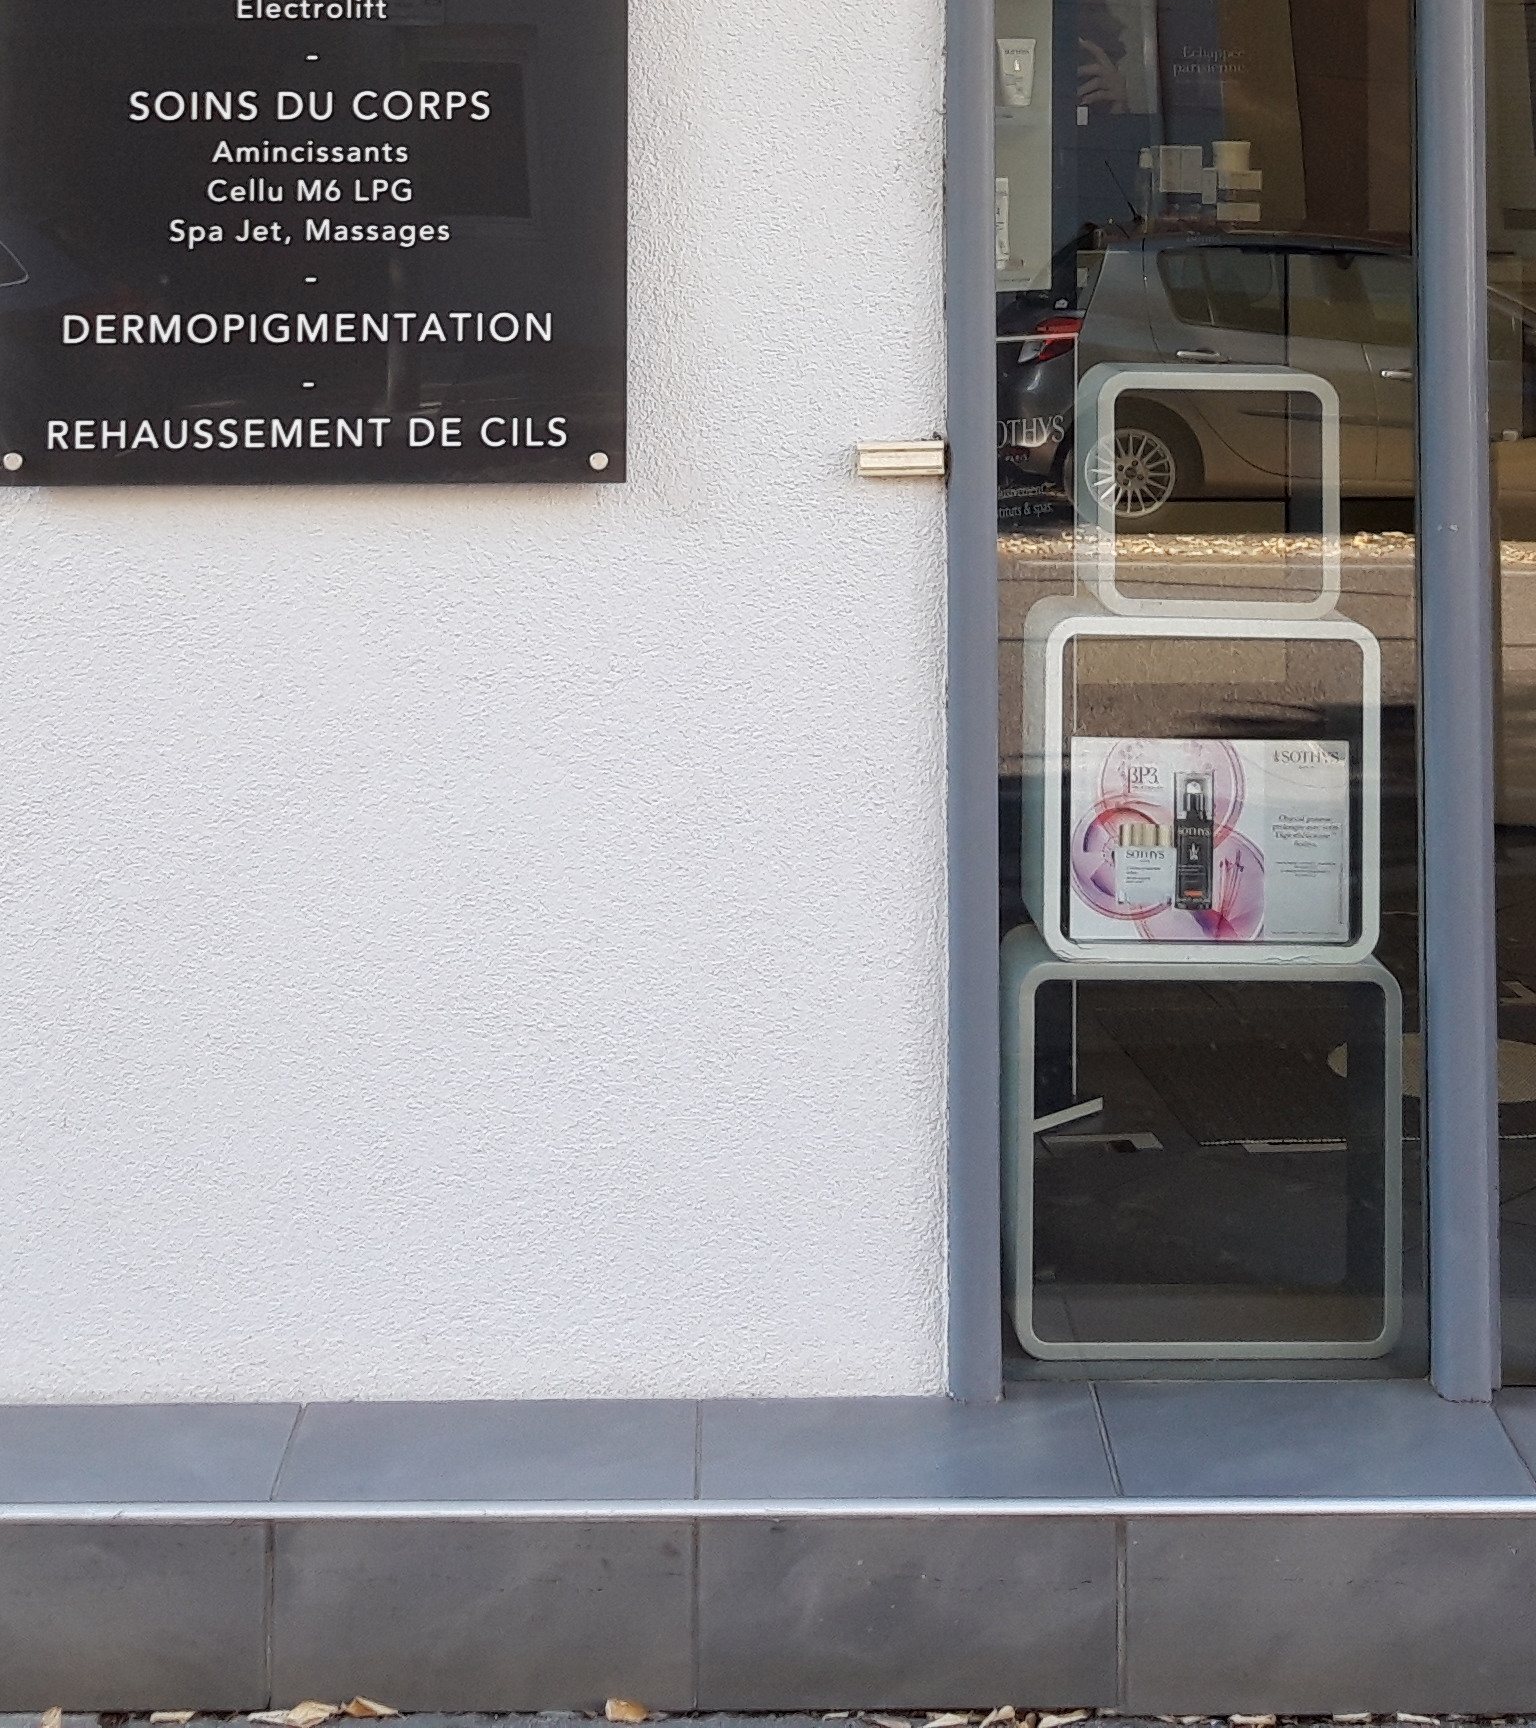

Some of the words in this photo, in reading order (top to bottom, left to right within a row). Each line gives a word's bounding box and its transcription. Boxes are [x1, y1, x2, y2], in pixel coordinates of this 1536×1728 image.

[130, 91, 257, 120] SOINS
[278, 92, 332, 120] DU
[353, 91, 489, 120] CORPS
[212, 141, 407, 162] Amincissants
[208, 178, 282, 202] Cellu
[298, 180, 340, 201] M6
[356, 179, 411, 201] LPG
[170, 220, 222, 249] Spa
[235, 220, 290, 244] Jet,
[306, 219, 449, 247] Massages
[63, 313, 551, 343] DERMOPIGMENTATION
[48, 418, 390, 449] REHAUSSEMENT
[410, 418, 461, 446] DE
[481, 417, 566, 446] CILS
